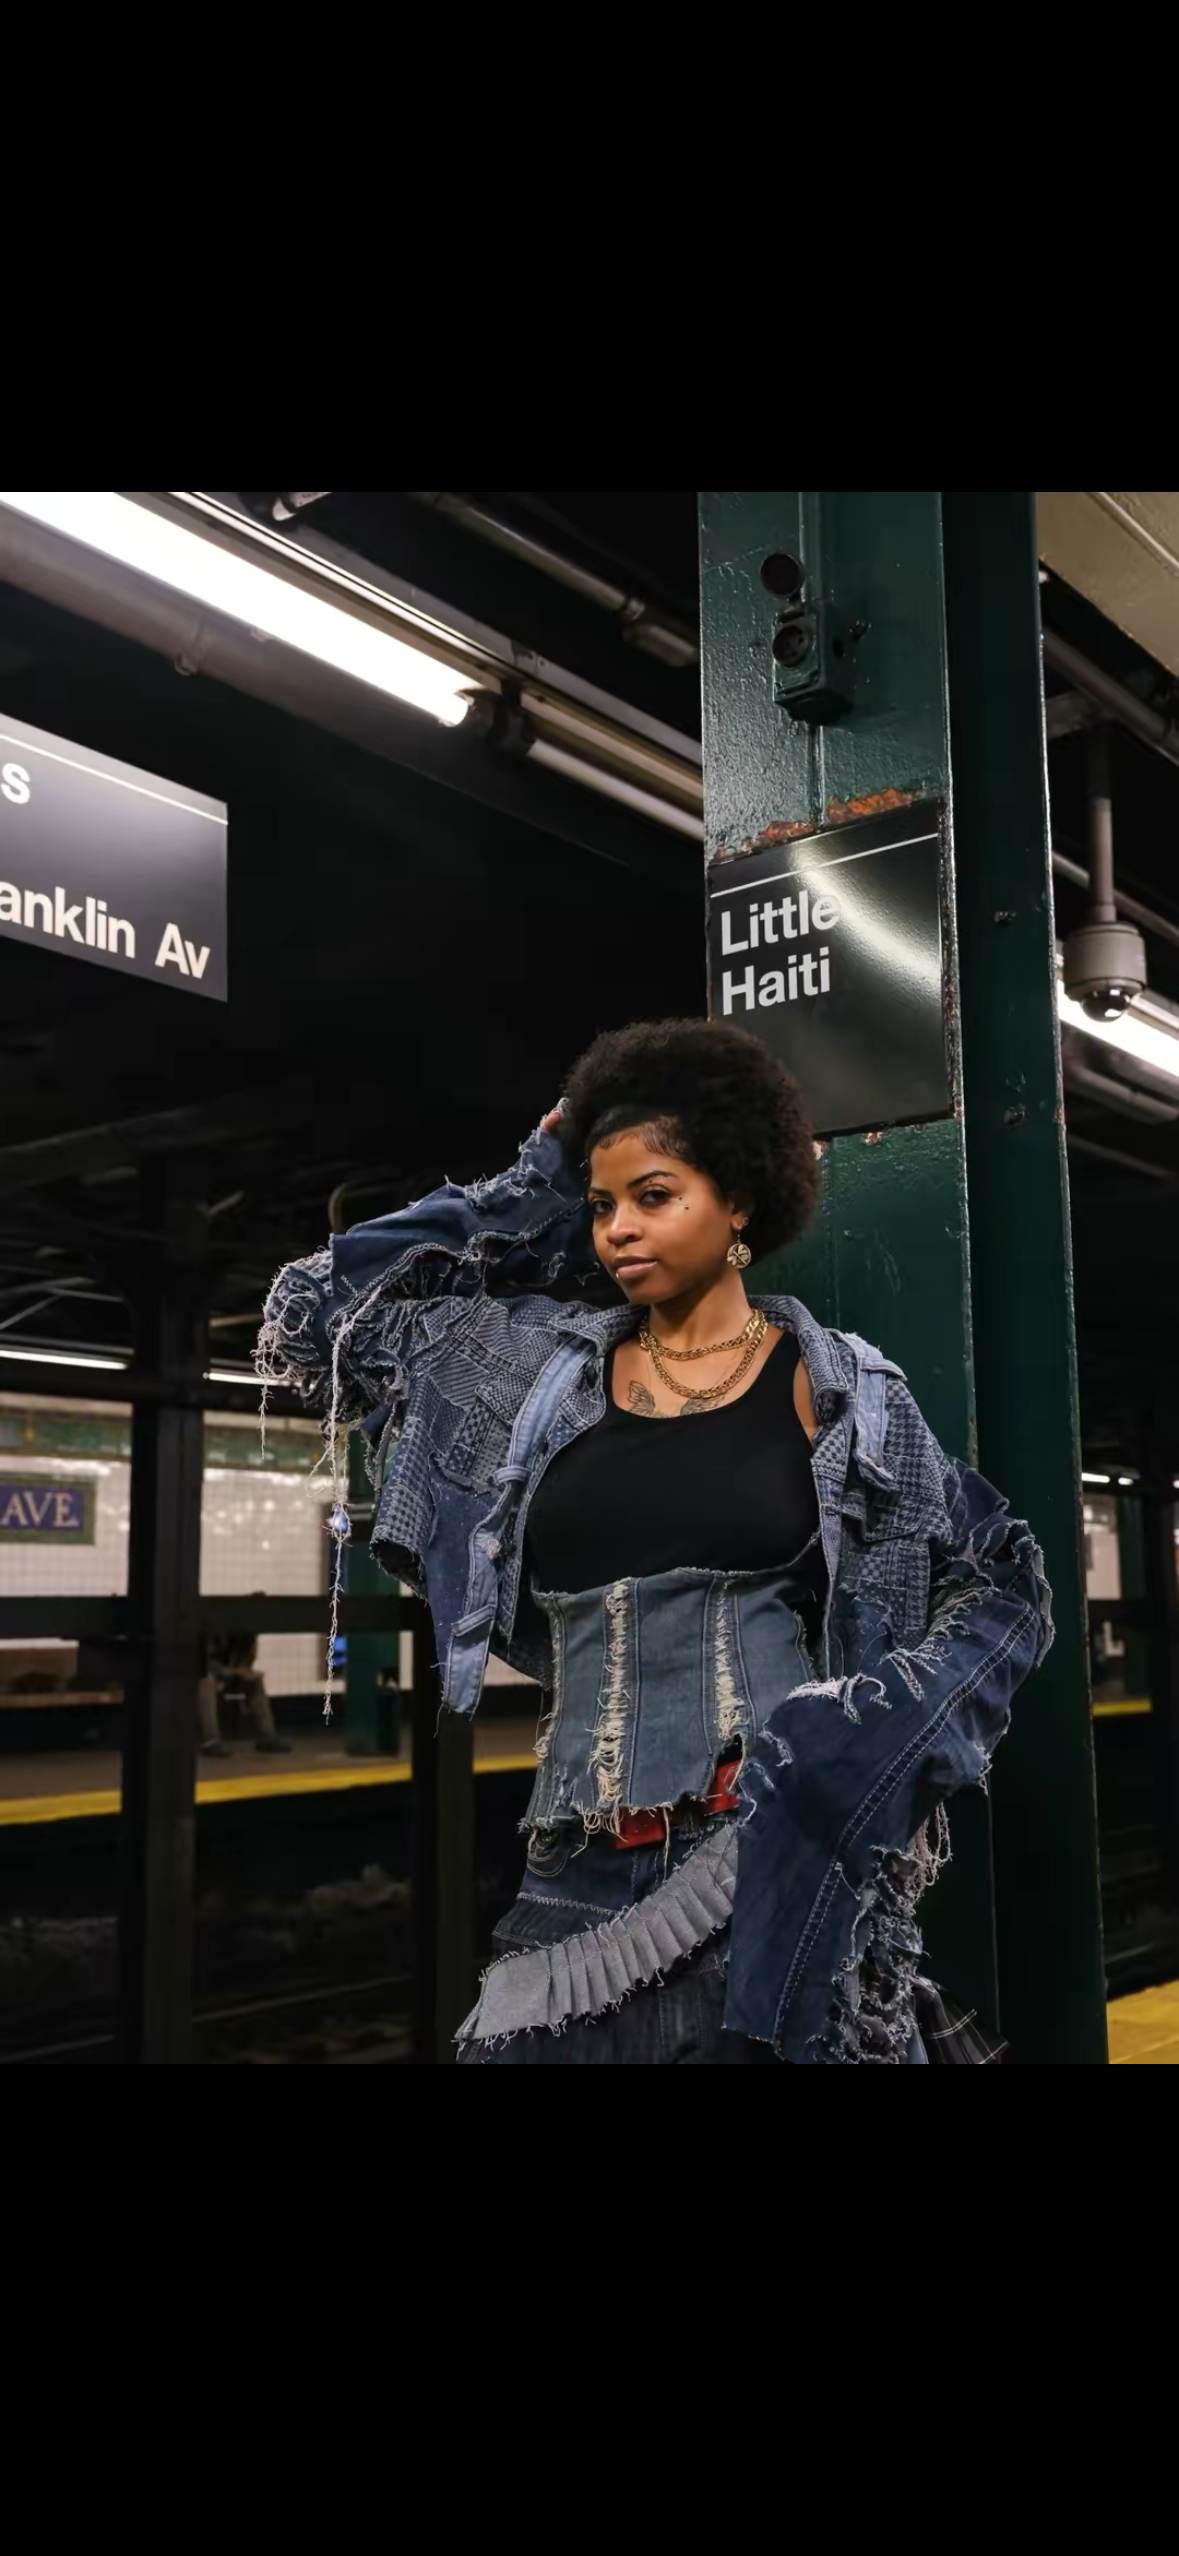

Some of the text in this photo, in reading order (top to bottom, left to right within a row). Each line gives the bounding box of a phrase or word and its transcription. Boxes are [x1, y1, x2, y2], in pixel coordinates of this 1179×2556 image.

[154, 922, 211, 979] Av
[721, 889, 841, 956] Little
[722, 946, 830, 1016] Haiti
[0, 1491, 80, 1527] AVE
